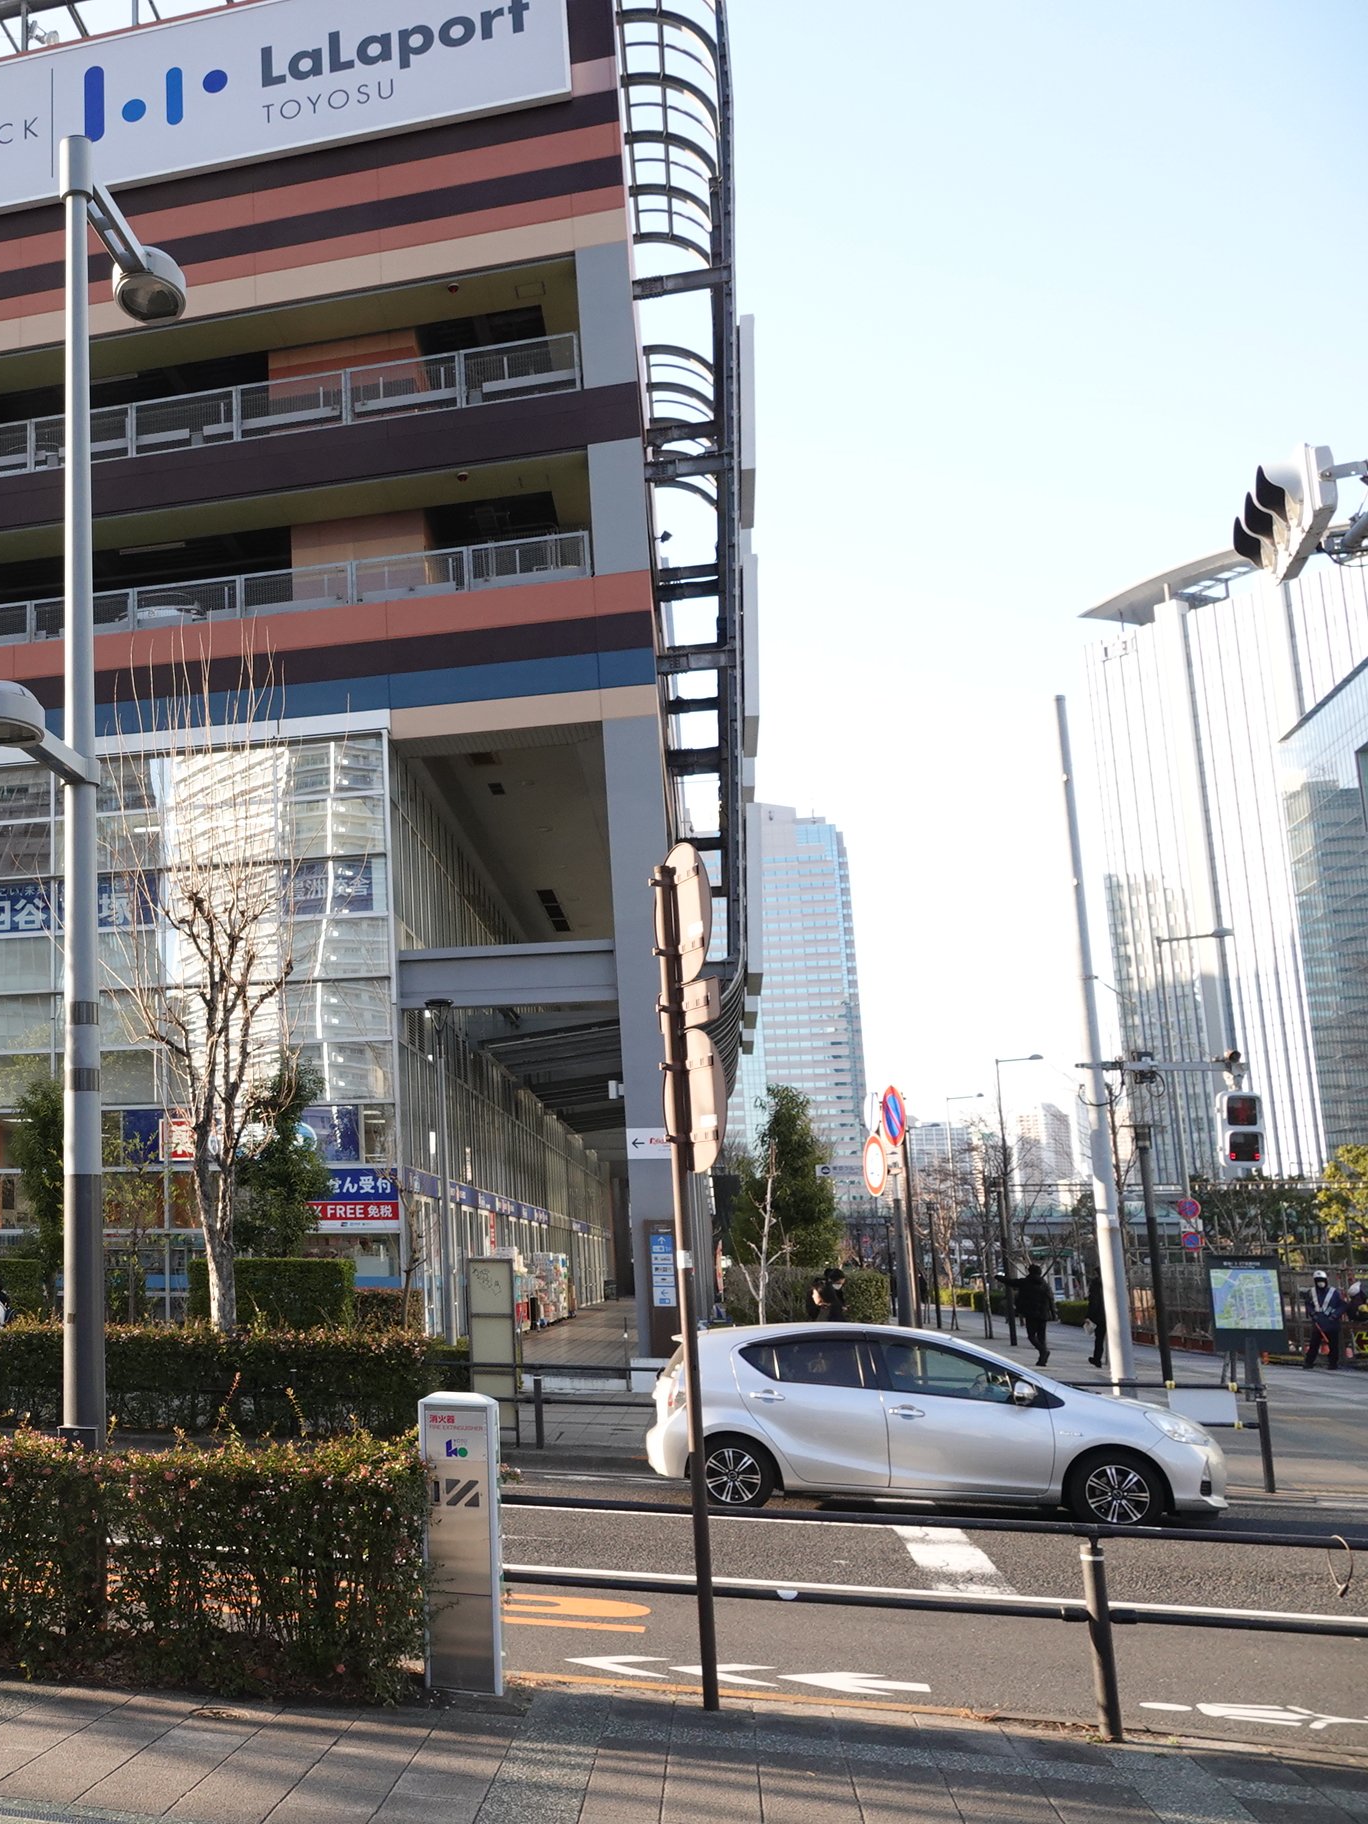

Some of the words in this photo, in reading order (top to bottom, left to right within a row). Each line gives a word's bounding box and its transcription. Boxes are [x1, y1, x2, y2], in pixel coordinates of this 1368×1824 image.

[260, 0, 530, 89] LaLaport
[262, 79, 397, 125] TOYOSU
[327, 1205, 365, 1218] FREE
[368, 1204, 393, 1218] 免税
[429, 1414, 456, 1424] 消火器
